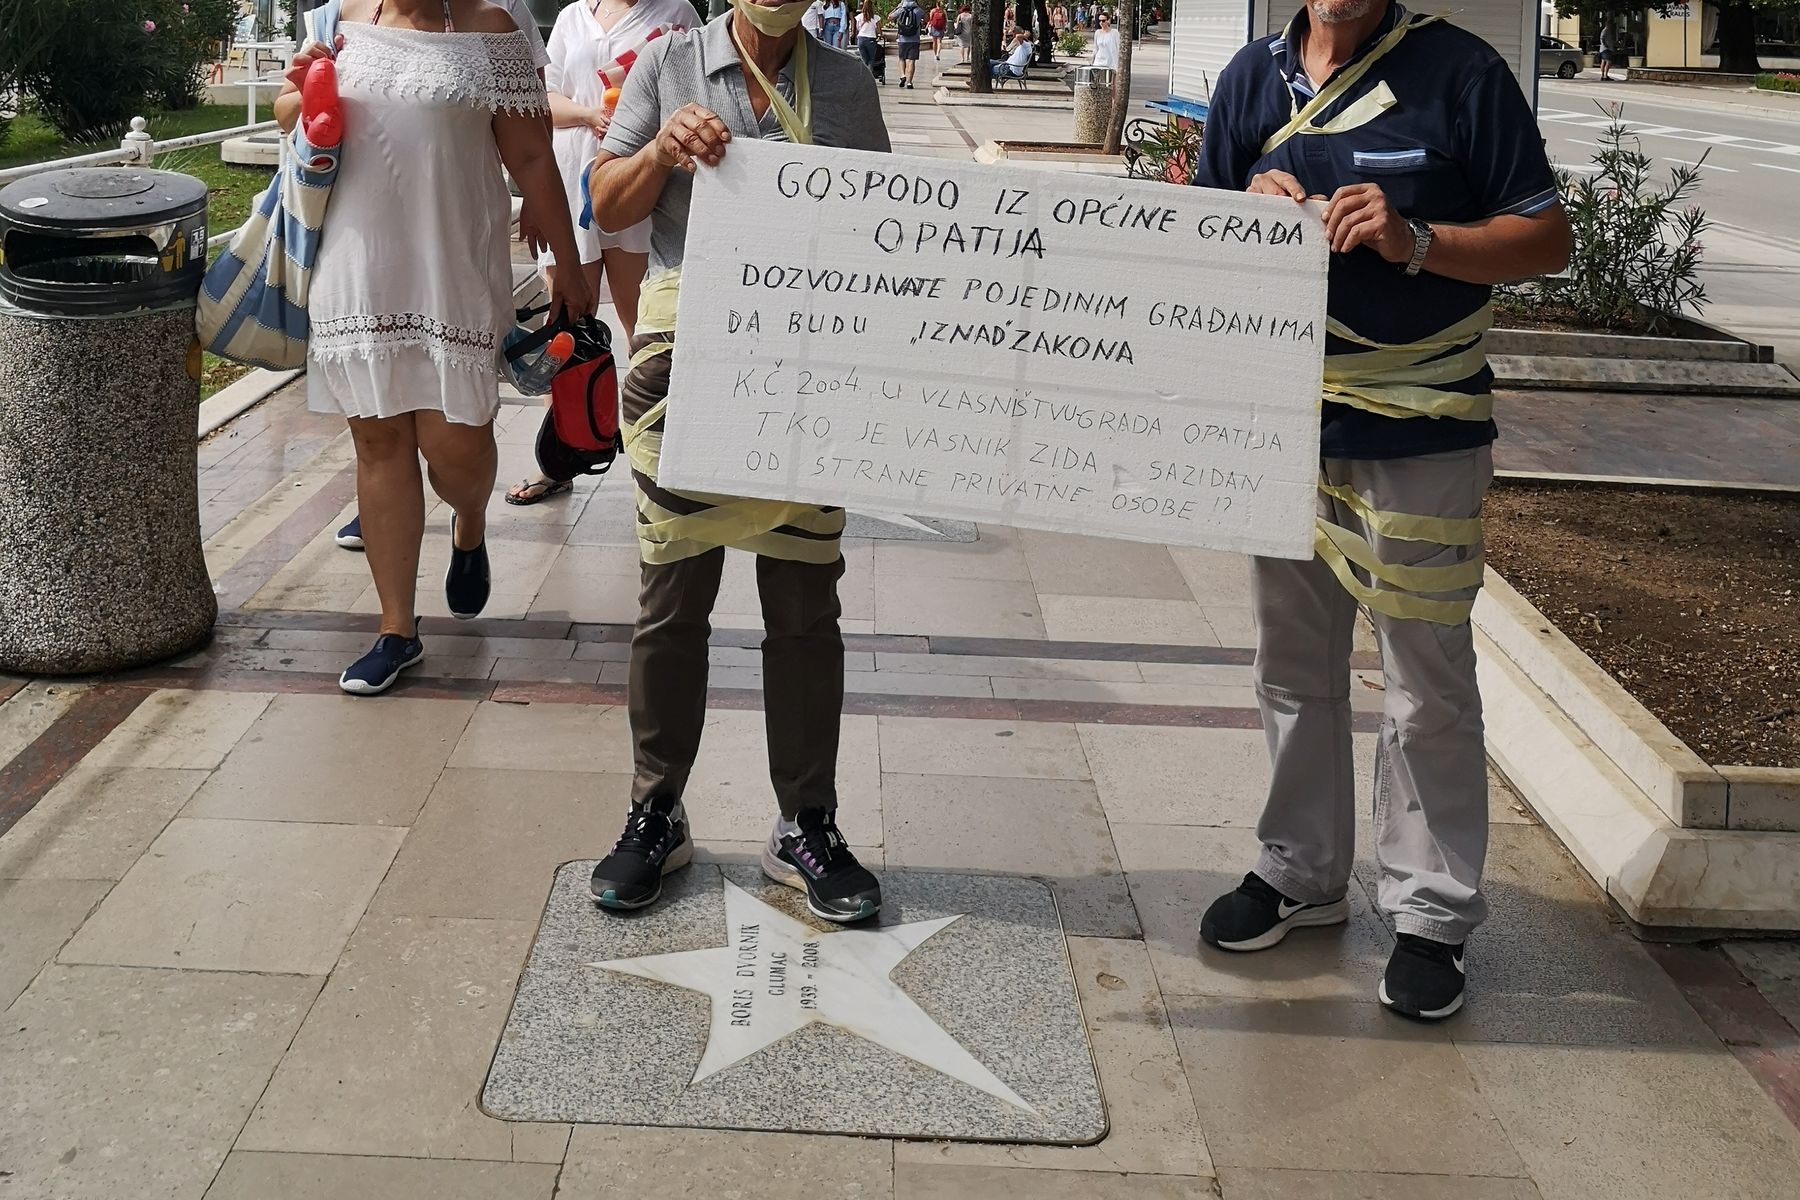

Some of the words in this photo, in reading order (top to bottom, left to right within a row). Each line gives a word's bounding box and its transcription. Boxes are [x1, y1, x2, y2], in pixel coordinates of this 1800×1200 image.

[777, 161, 960, 210] GOSPODO
[994, 188, 1030, 216] IZ
[1053, 193, 1177, 233] OPĆINE
[1197, 215, 1304, 246] GRADA
[874, 217, 1047, 259] OPATIJA
[727, 309, 760, 334] DA
[788, 311, 868, 335] BUDU
[741, 263, 947, 299] DOZVOLJAVATE
[962, 278, 1129, 319] POJEDINIM
[1148, 301, 1315, 344] GRAĐANIMA
[882, 380, 902, 400] U
[1183, 423, 1282, 452] OPATIJA
[757, 411, 831, 439] TKO
[855, 421, 889, 445] JE
[905, 426, 1011, 457] VASNIK
[1029, 442, 1097, 474] ZIDA
[1149, 460, 1264, 493] SAZIDAN
[746, 450, 780, 471] OD
[810, 456, 937, 487] STRANE
[950, 472, 1094, 502] PRIVATNE
[1111, 493, 1199, 520] OSOBE
[736, 923, 760, 978] DVORNIK
[768, 951, 788, 996] GLUMAC
[730, 988, 753, 1027] BORIS
